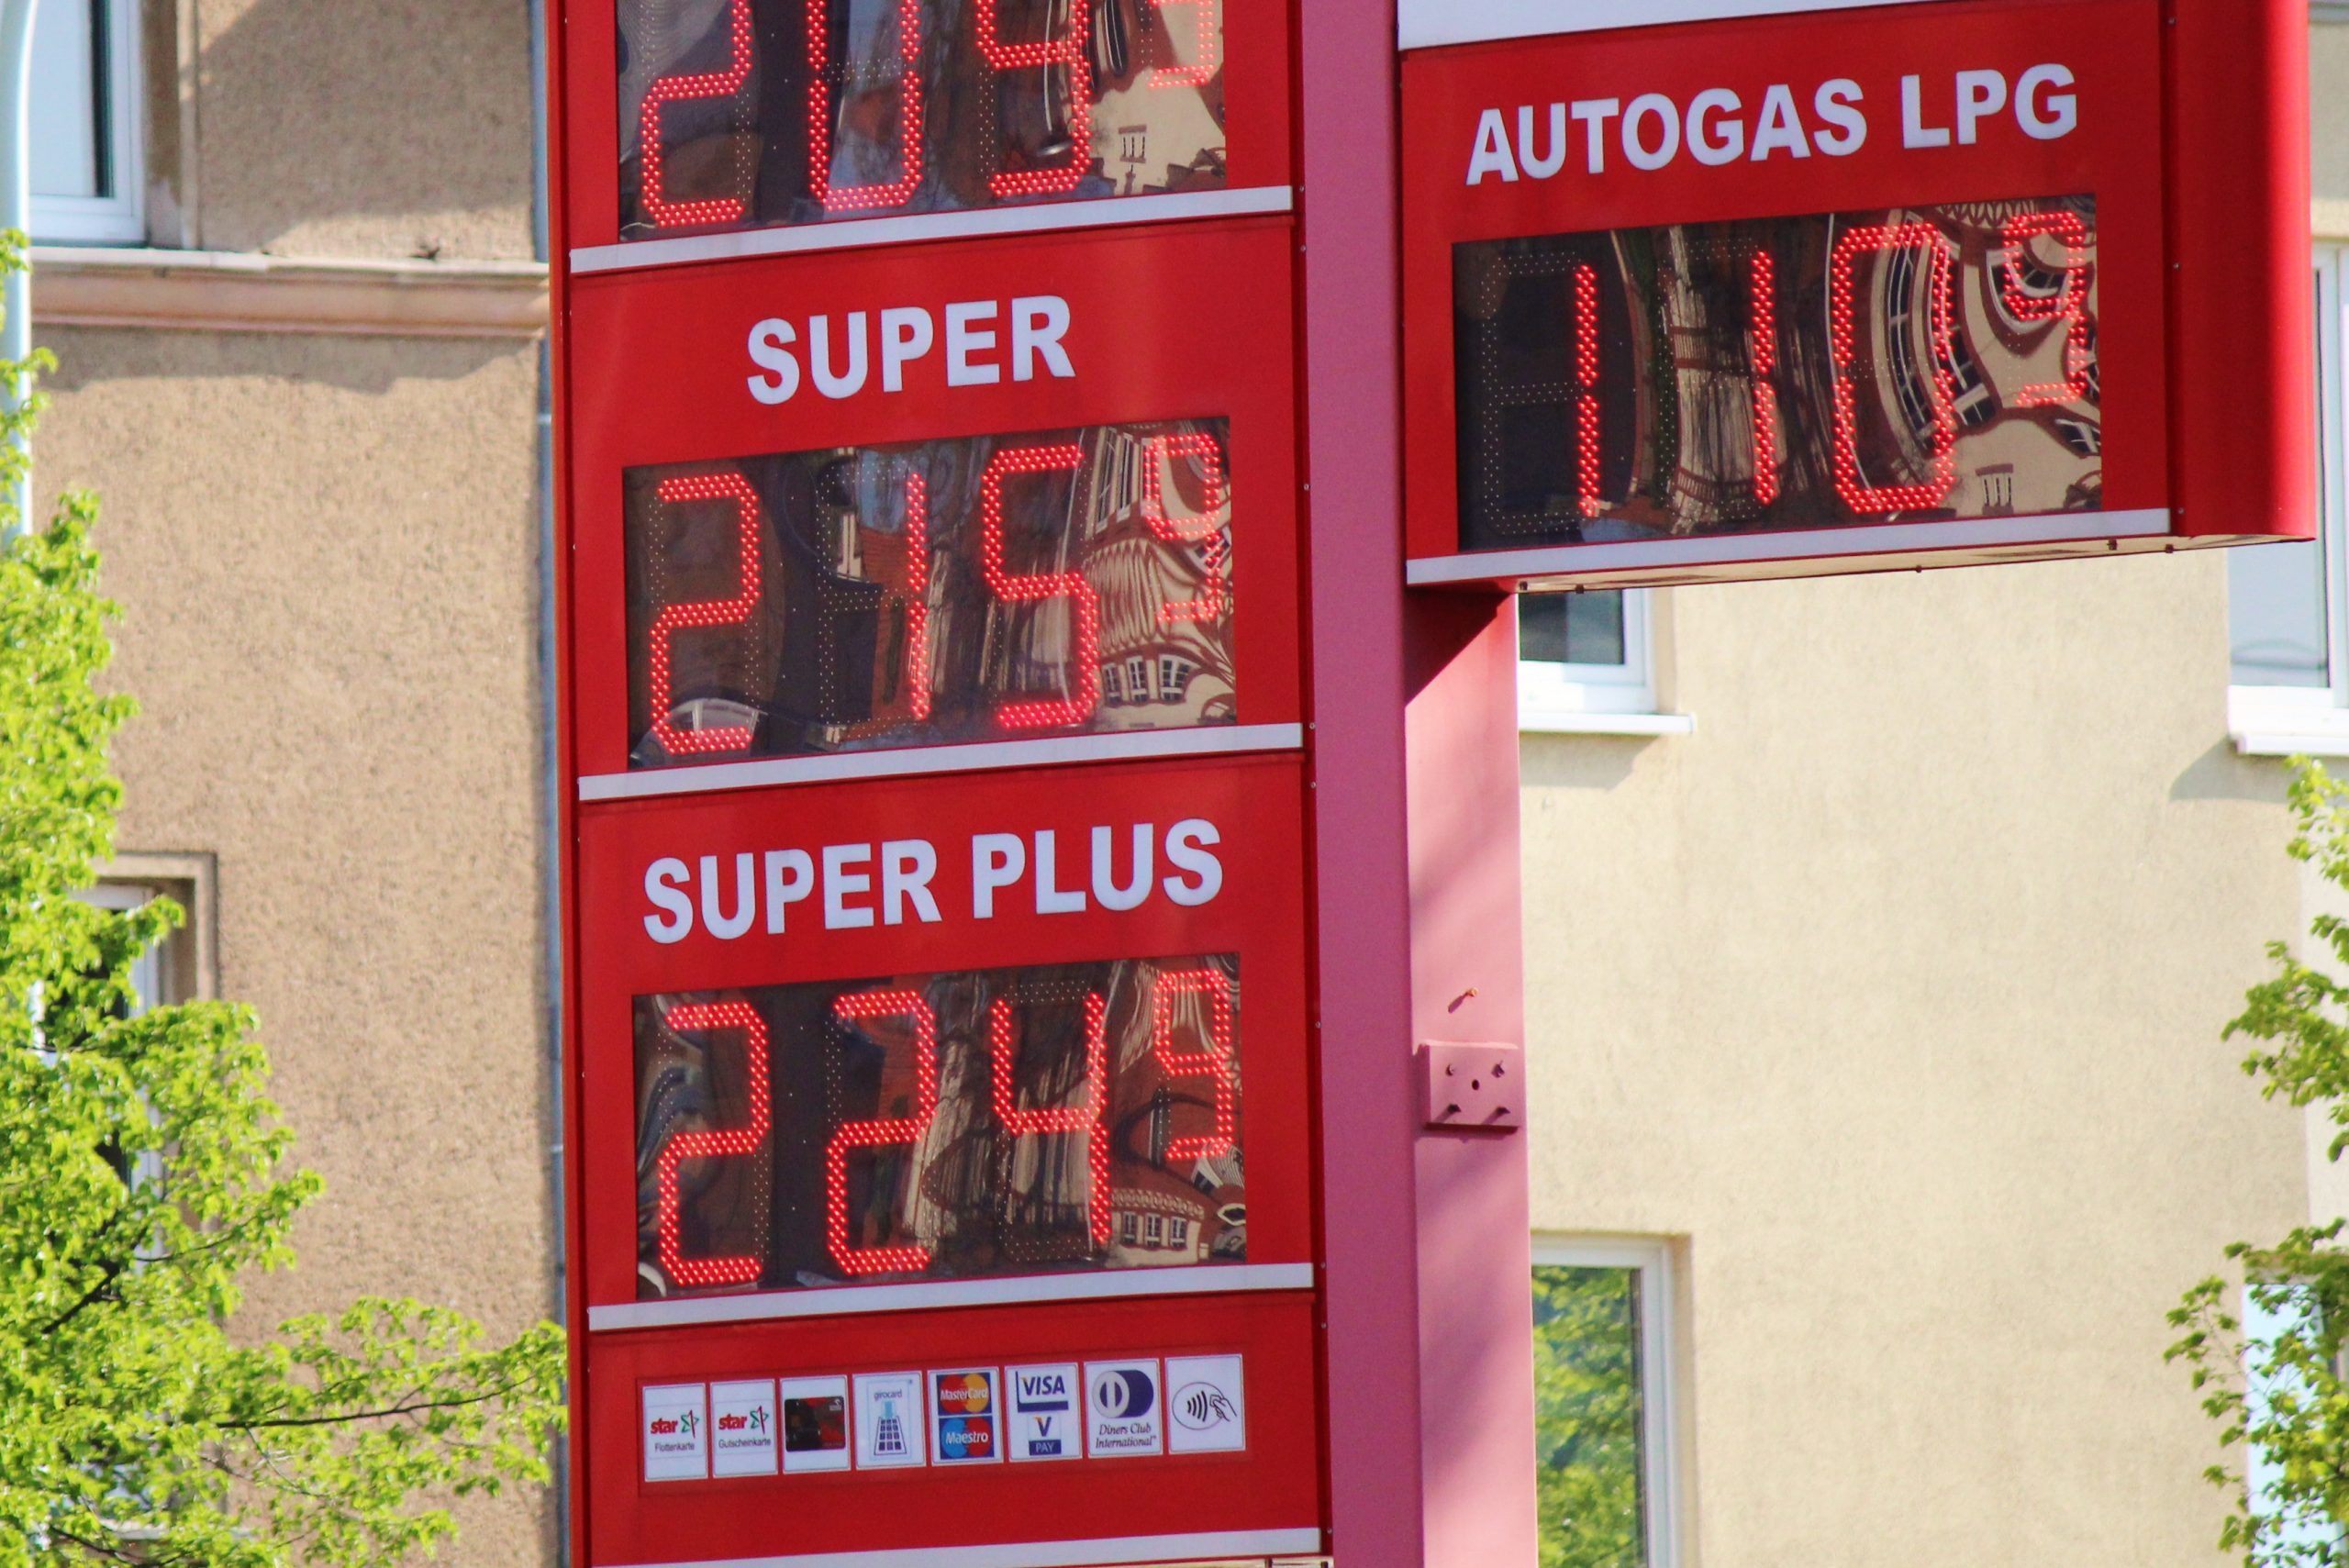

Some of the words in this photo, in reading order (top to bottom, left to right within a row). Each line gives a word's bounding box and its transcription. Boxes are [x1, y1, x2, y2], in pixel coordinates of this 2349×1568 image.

[1467, 77, 1867, 185] AUTOGAS
[1901, 63, 2077, 149] LPG
[746, 295, 1076, 405] SUPER
[643, 839, 942, 944] SUPER
[972, 818, 1222, 919] PLUS
[1020, 1374, 1066, 1396] VISA
[874, 1388, 903, 1401] girocard
[940, 1386, 989, 1401] MasterCard
[651, 1418, 678, 1434] star
[718, 1413, 748, 1430] star
[1099, 1423, 1129, 1435] Diners
[1130, 1422, 1152, 1434] Club
[718, 1437, 772, 1449] Gutscheinkarte
[945, 1431, 988, 1445] Maestro
[654, 1441, 695, 1452] Flottenkarte
[1035, 1442, 1054, 1453] PAY
